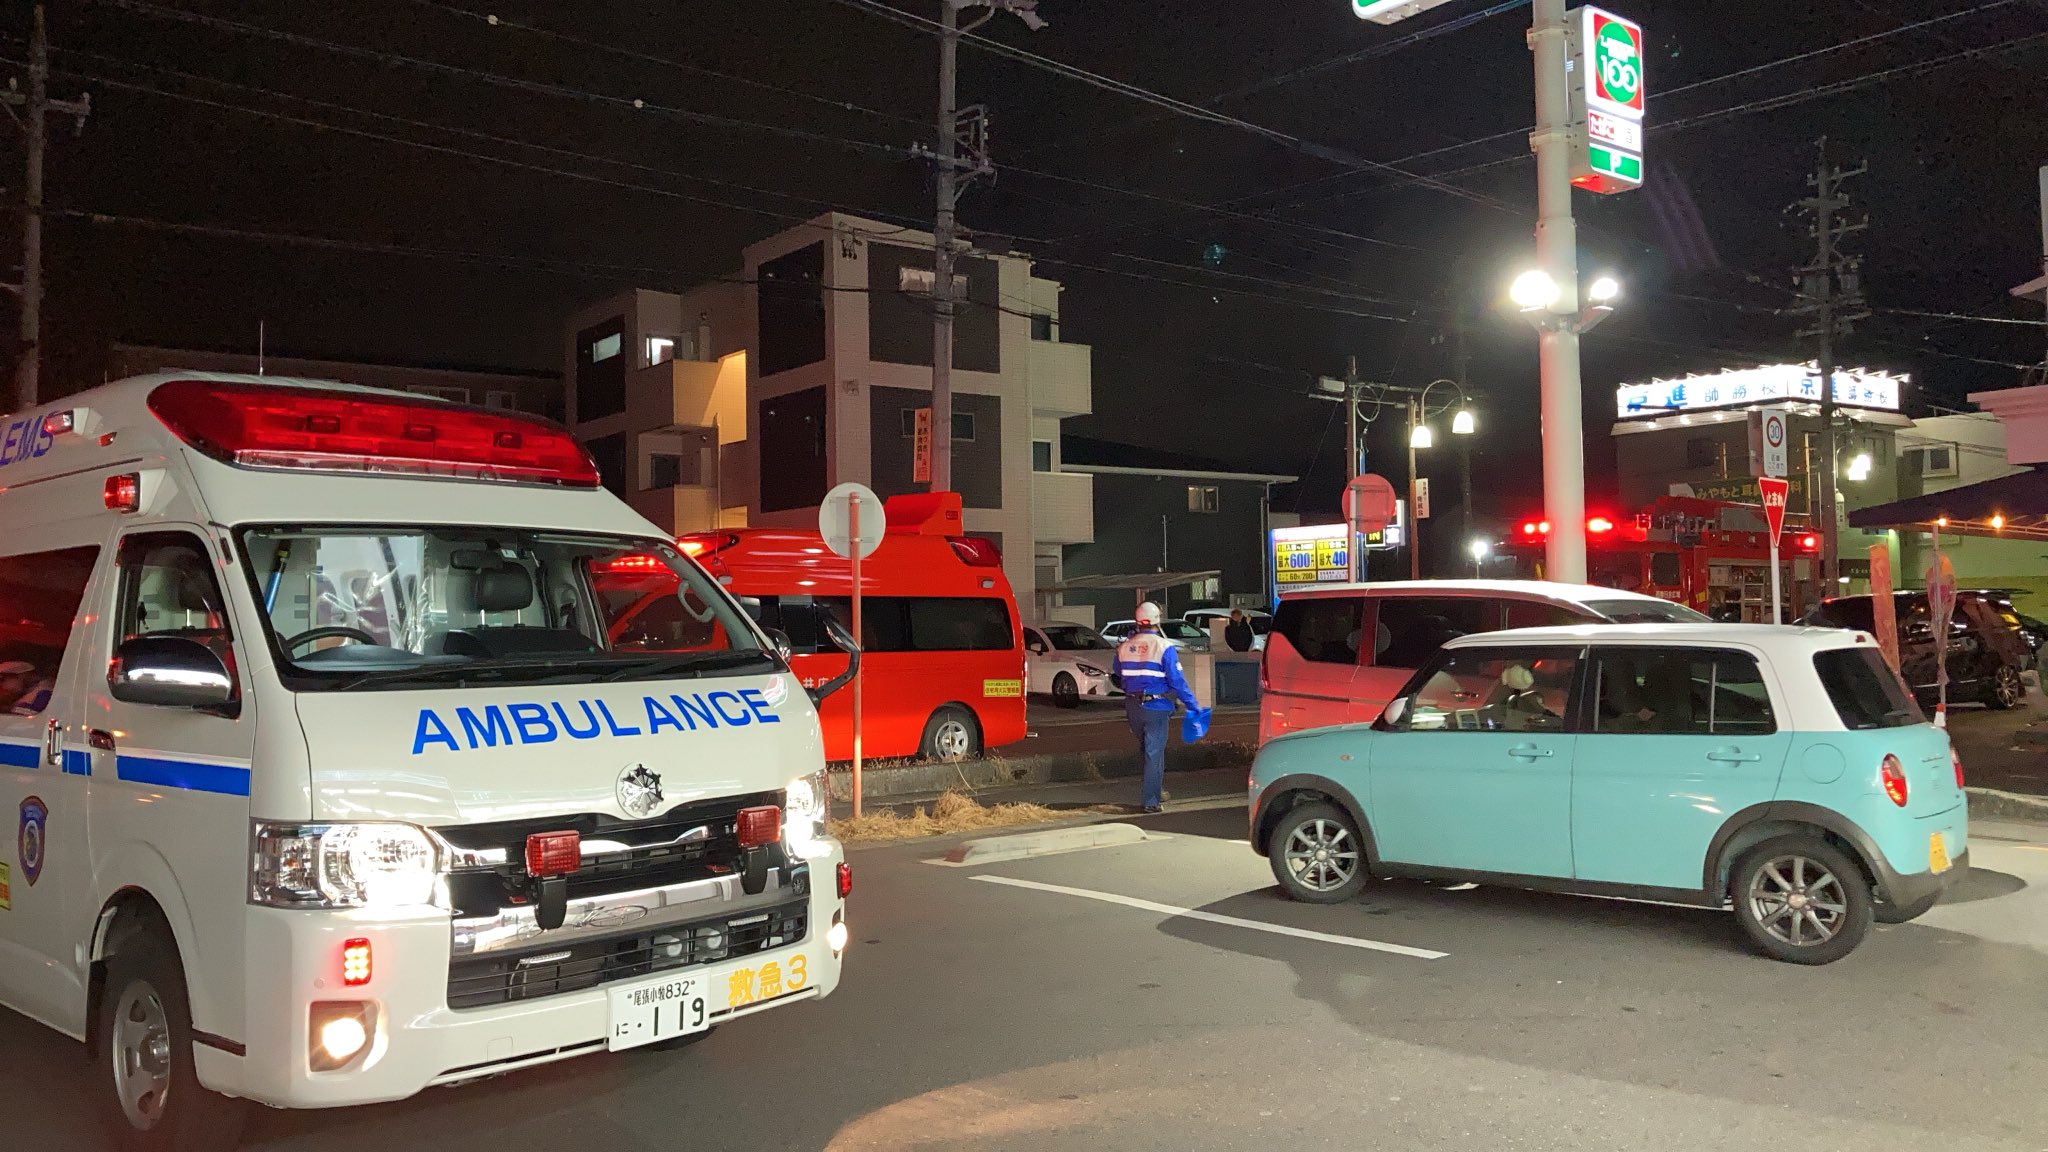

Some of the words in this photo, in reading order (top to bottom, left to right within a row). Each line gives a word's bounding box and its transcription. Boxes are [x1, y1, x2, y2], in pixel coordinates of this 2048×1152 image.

[1601, 54, 1639, 94] 100
[1609, 151, 1622, 174] P
[1769, 424, 1780, 439] 30
[1765, 491, 1784, 507] 止まれ
[1319, 551, 1348, 567] 最大40
[412, 689, 781, 755] AMBULANCE
